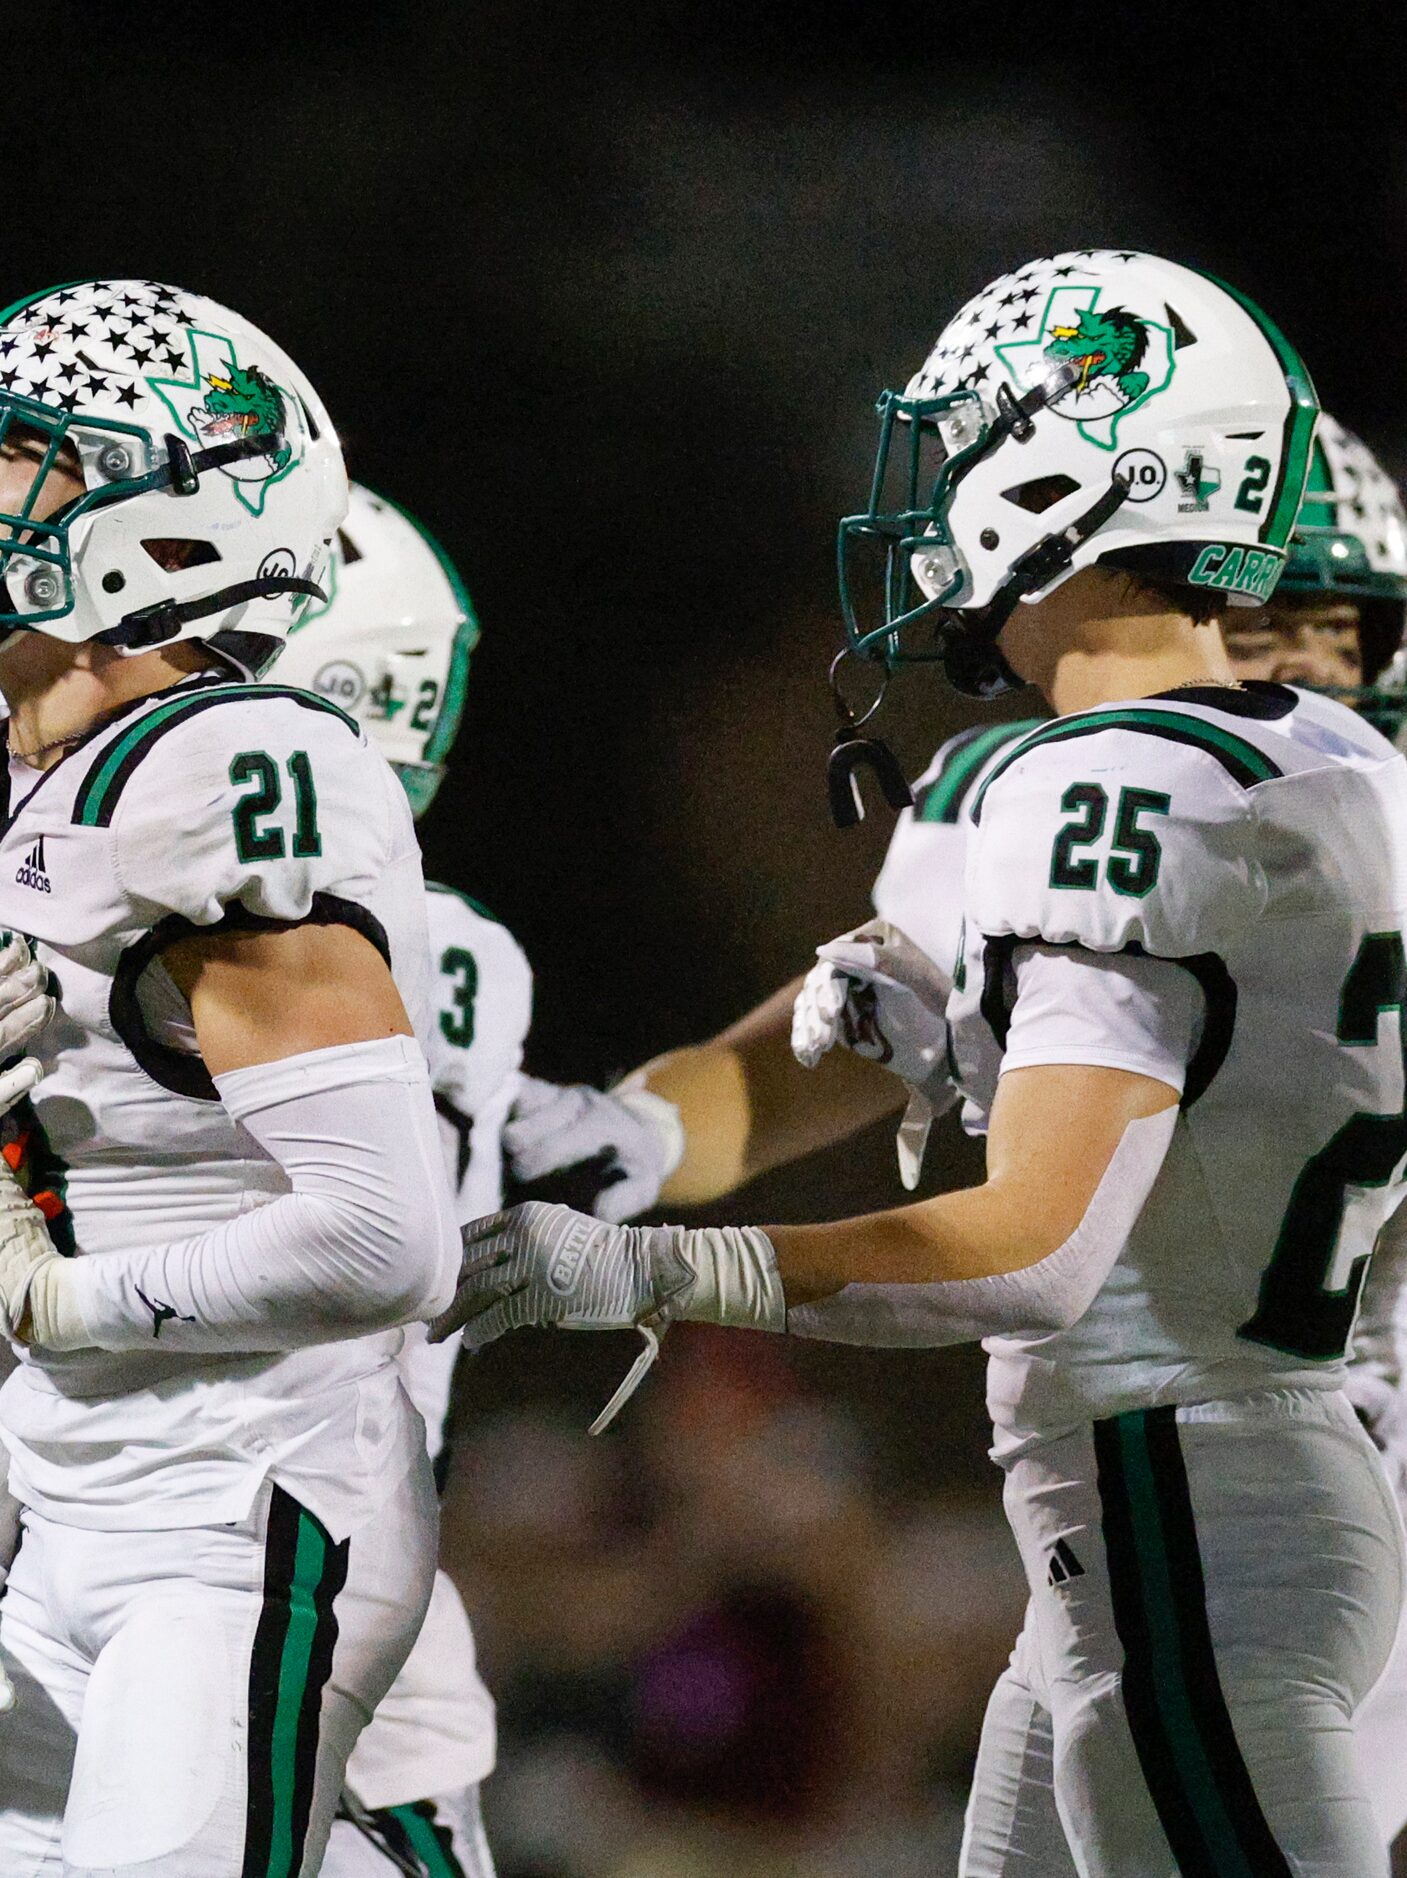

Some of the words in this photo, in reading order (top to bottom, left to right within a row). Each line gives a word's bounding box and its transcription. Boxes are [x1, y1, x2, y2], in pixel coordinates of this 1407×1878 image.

[1234, 455, 1271, 514] 2
[1188, 545, 1284, 597] CARR
[409, 680, 439, 731] 2
[230, 750, 322, 864] 21
[1049, 781, 1171, 898] 25
[15, 867, 51, 893] adidas
[439, 946, 479, 1049] 3
